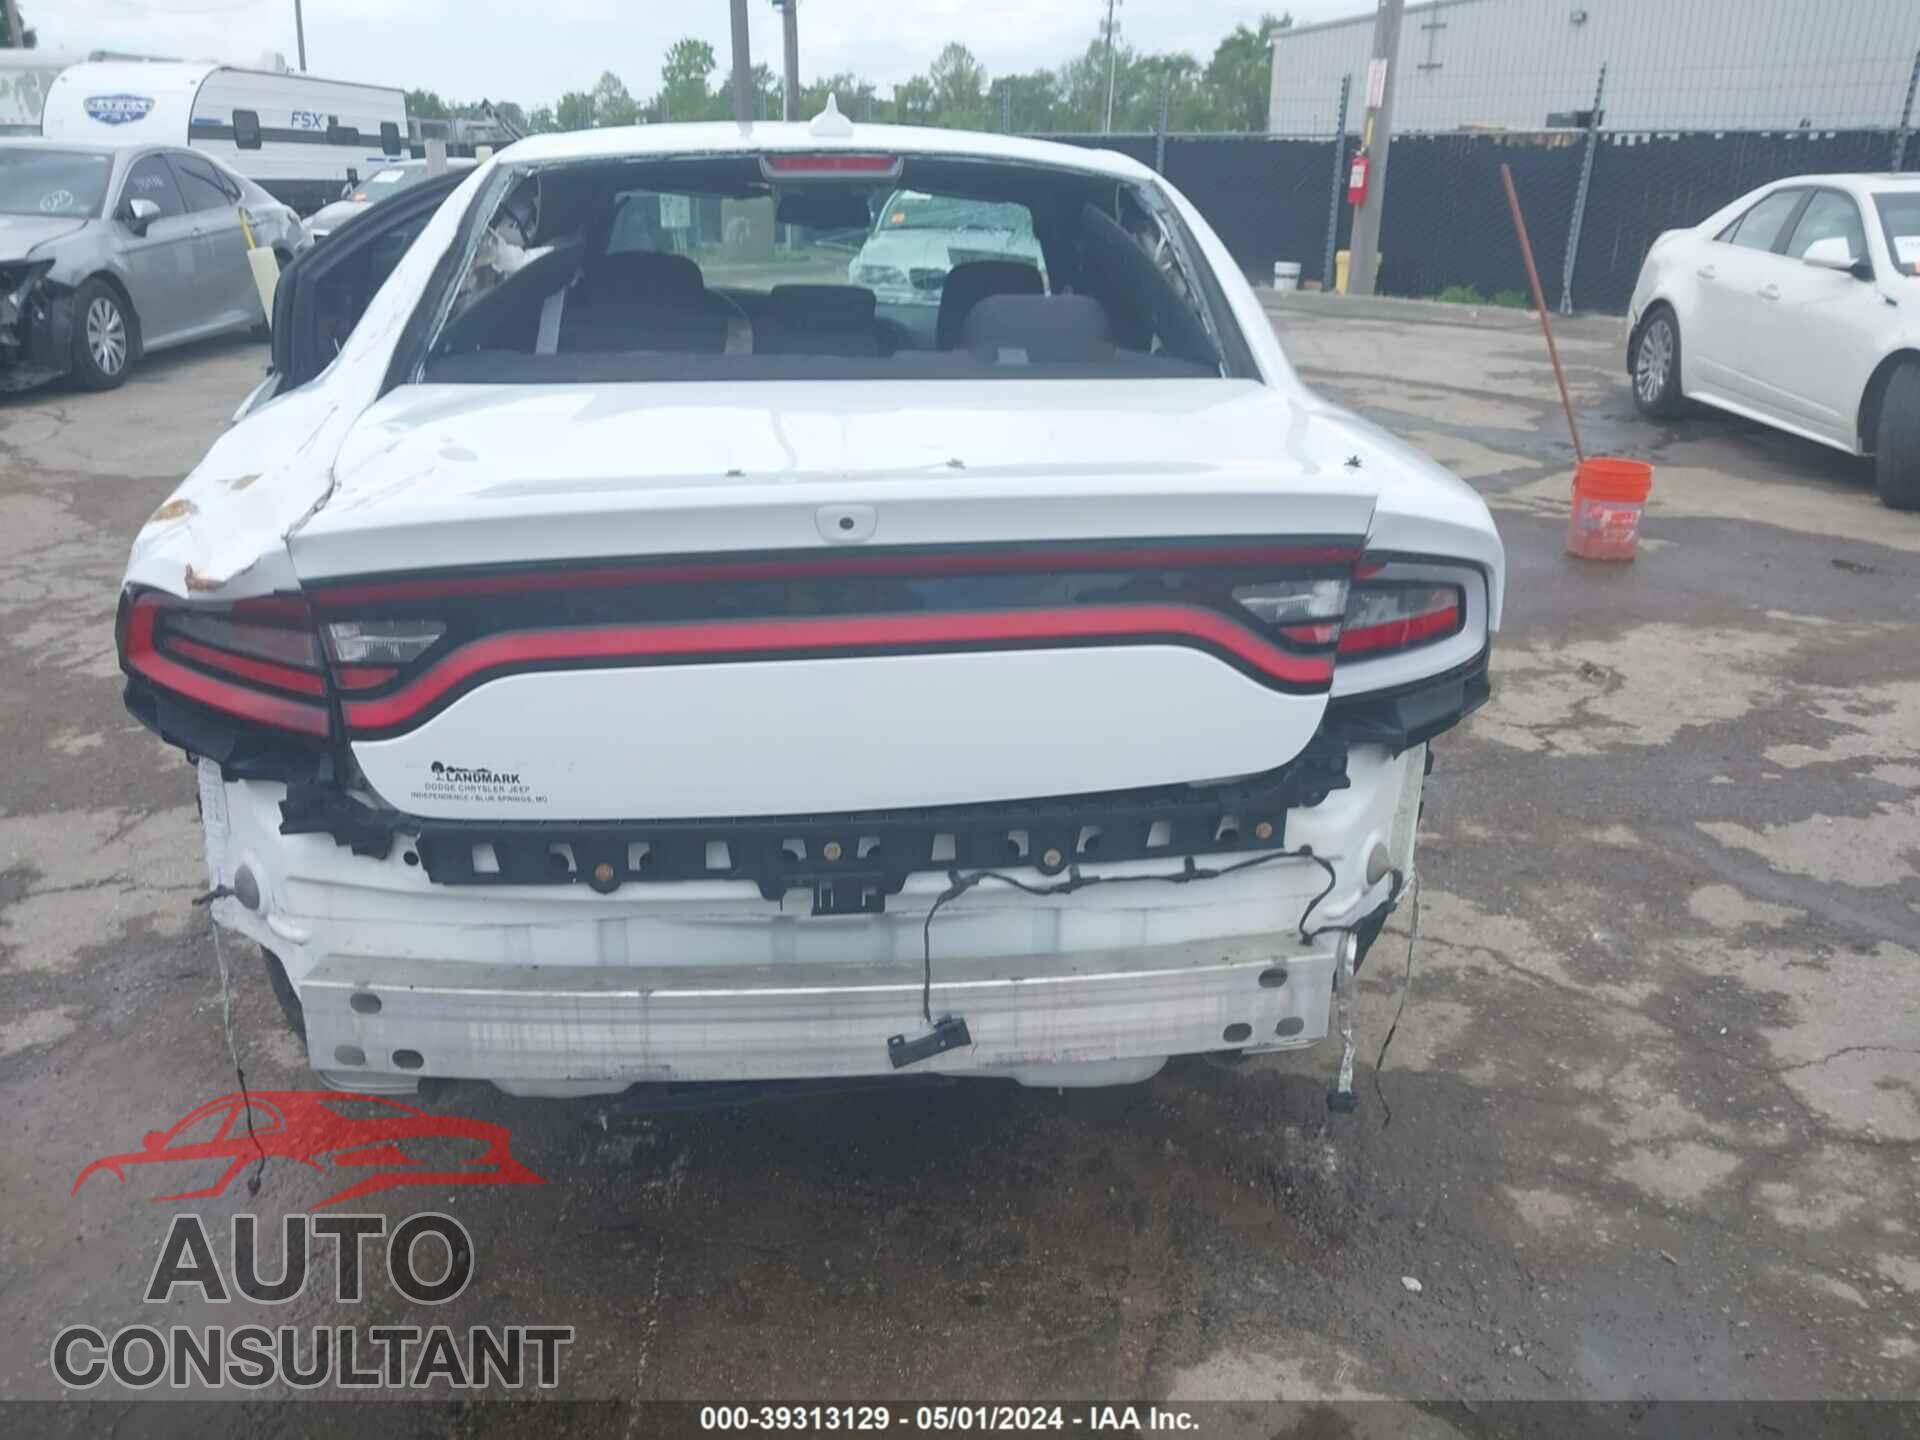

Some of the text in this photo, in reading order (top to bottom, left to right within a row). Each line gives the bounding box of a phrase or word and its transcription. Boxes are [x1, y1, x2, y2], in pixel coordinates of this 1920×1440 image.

[291, 111, 322, 129] FSX
[446, 772, 520, 784] LANDMARK
[424, 783, 530, 794] DODGE CHRYSLER JEEP
[410, 792, 468, 801] INDEPENDENCE
